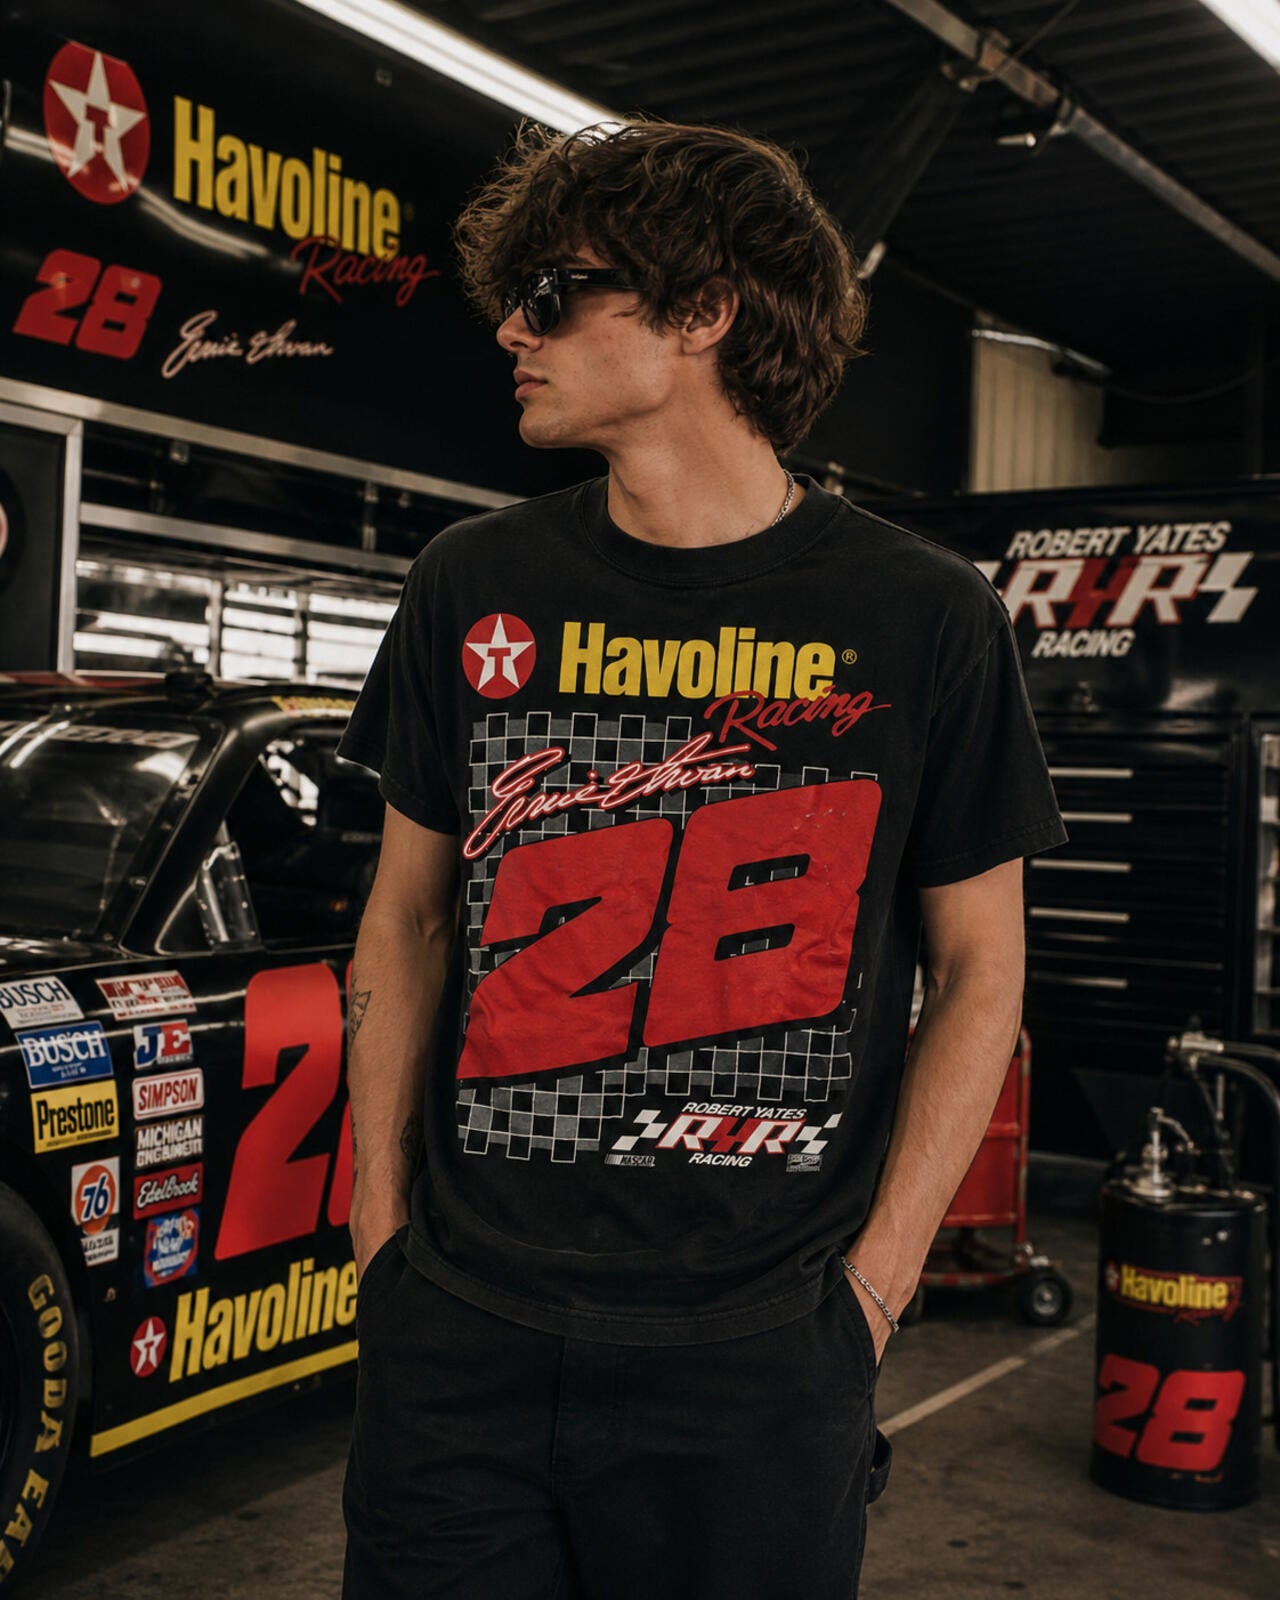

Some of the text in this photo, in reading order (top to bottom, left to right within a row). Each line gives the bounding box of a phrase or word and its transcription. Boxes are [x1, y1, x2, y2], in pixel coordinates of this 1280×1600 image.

[174, 95, 400, 262] Havoline
[290, 235, 441, 307] Racing
[12, 248, 163, 360] 28
[1005, 520, 1232, 559] ROBERT YATES
[559, 621, 836, 701] Havoline
[1031, 628, 1136, 659] RACING
[703, 685, 891, 751] Racing
[456, 779, 882, 1080] 28
[0, 980, 71, 1009] BUSCH
[22, 1030, 107, 1067] BUSCH
[138, 1077, 198, 1111] SIMPSON
[214, 960, 354, 1261] 2
[682, 1102, 808, 1120] ROBERT YATES
[36, 1096, 115, 1140] Prestone
[137, 1118, 202, 1150] MICHIGAN
[688, 1152, 753, 1168] RACING
[81, 1175, 110, 1221] 76
[1121, 1264, 1229, 1311] Havoline
[168, 1258, 358, 1384] Havoline
[1094, 1352, 1247, 1472] 28
